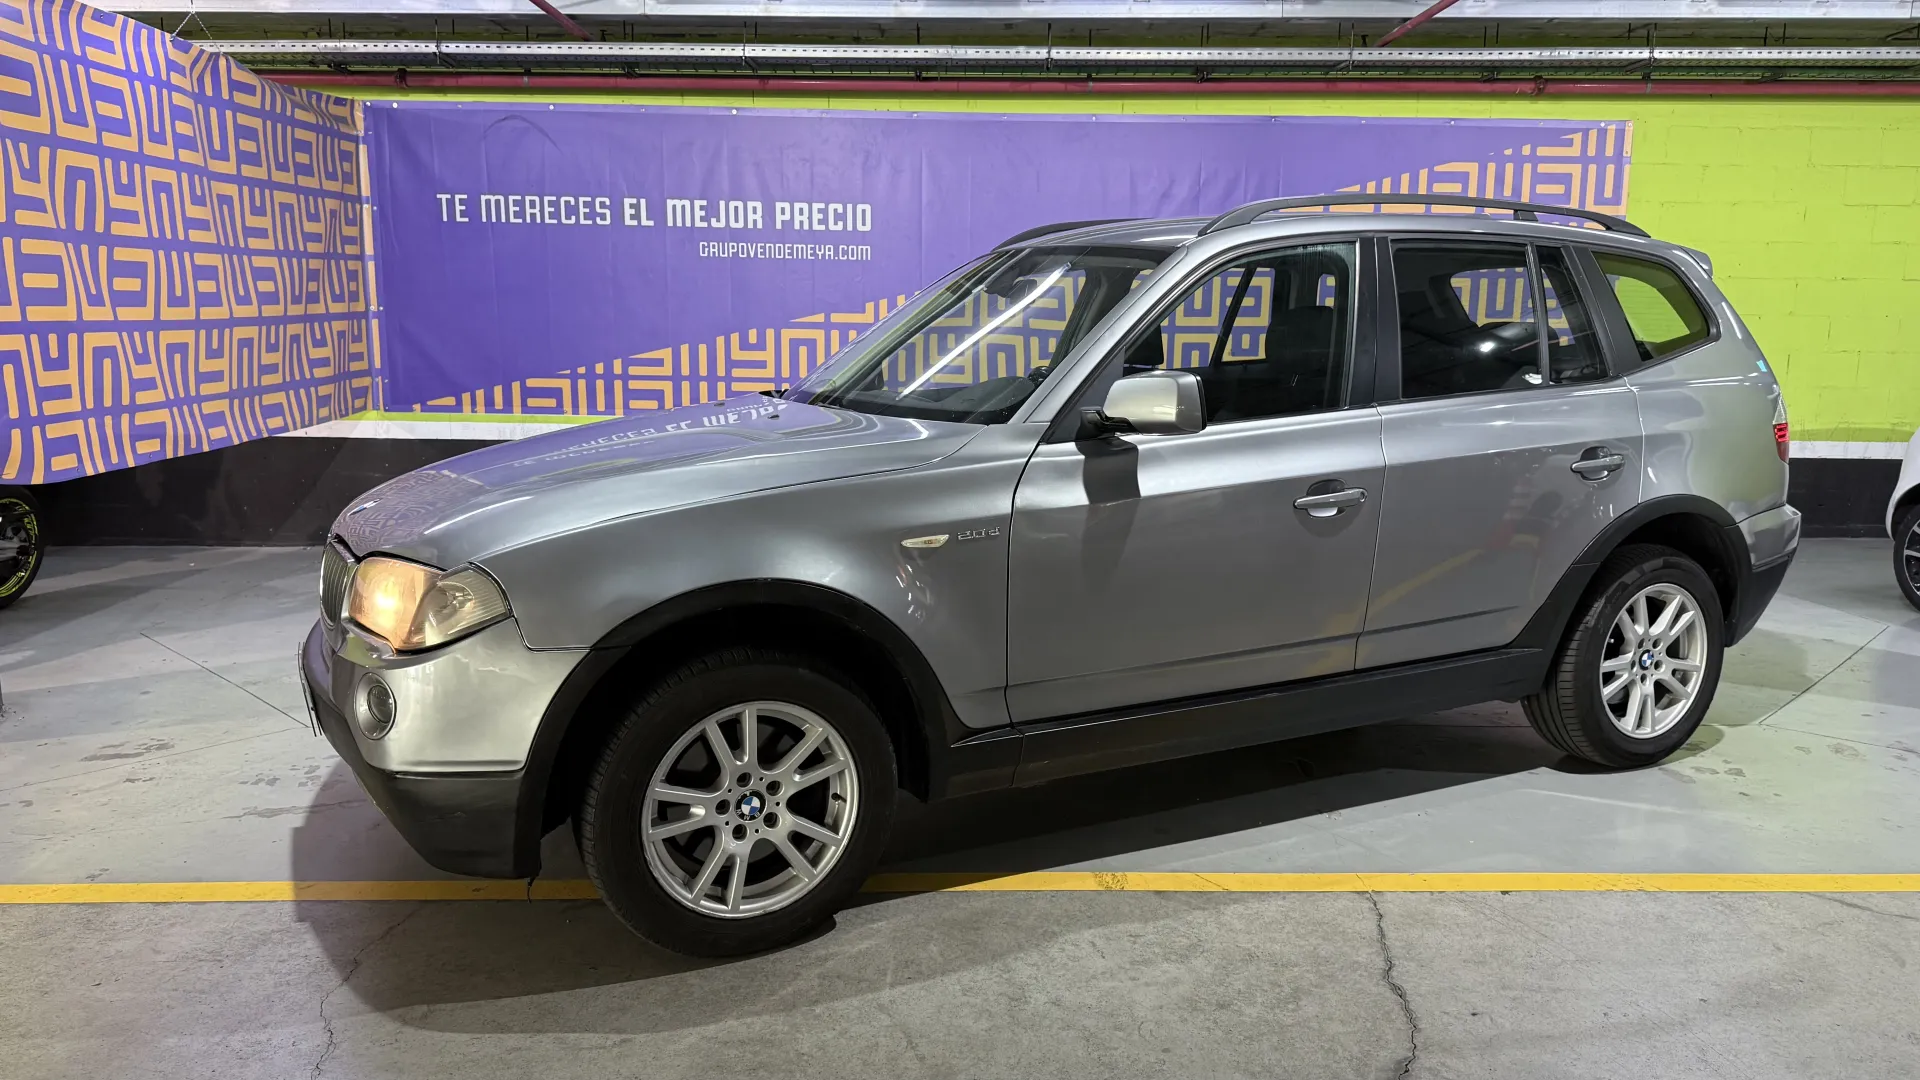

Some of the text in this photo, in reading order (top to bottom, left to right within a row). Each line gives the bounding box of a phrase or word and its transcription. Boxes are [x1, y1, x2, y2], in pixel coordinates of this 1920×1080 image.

[436, 193, 872, 232] TE MERECES EL MEJOR PRECIO
[699, 241, 871, 261] GRUPOVENDEMEYA.COM
